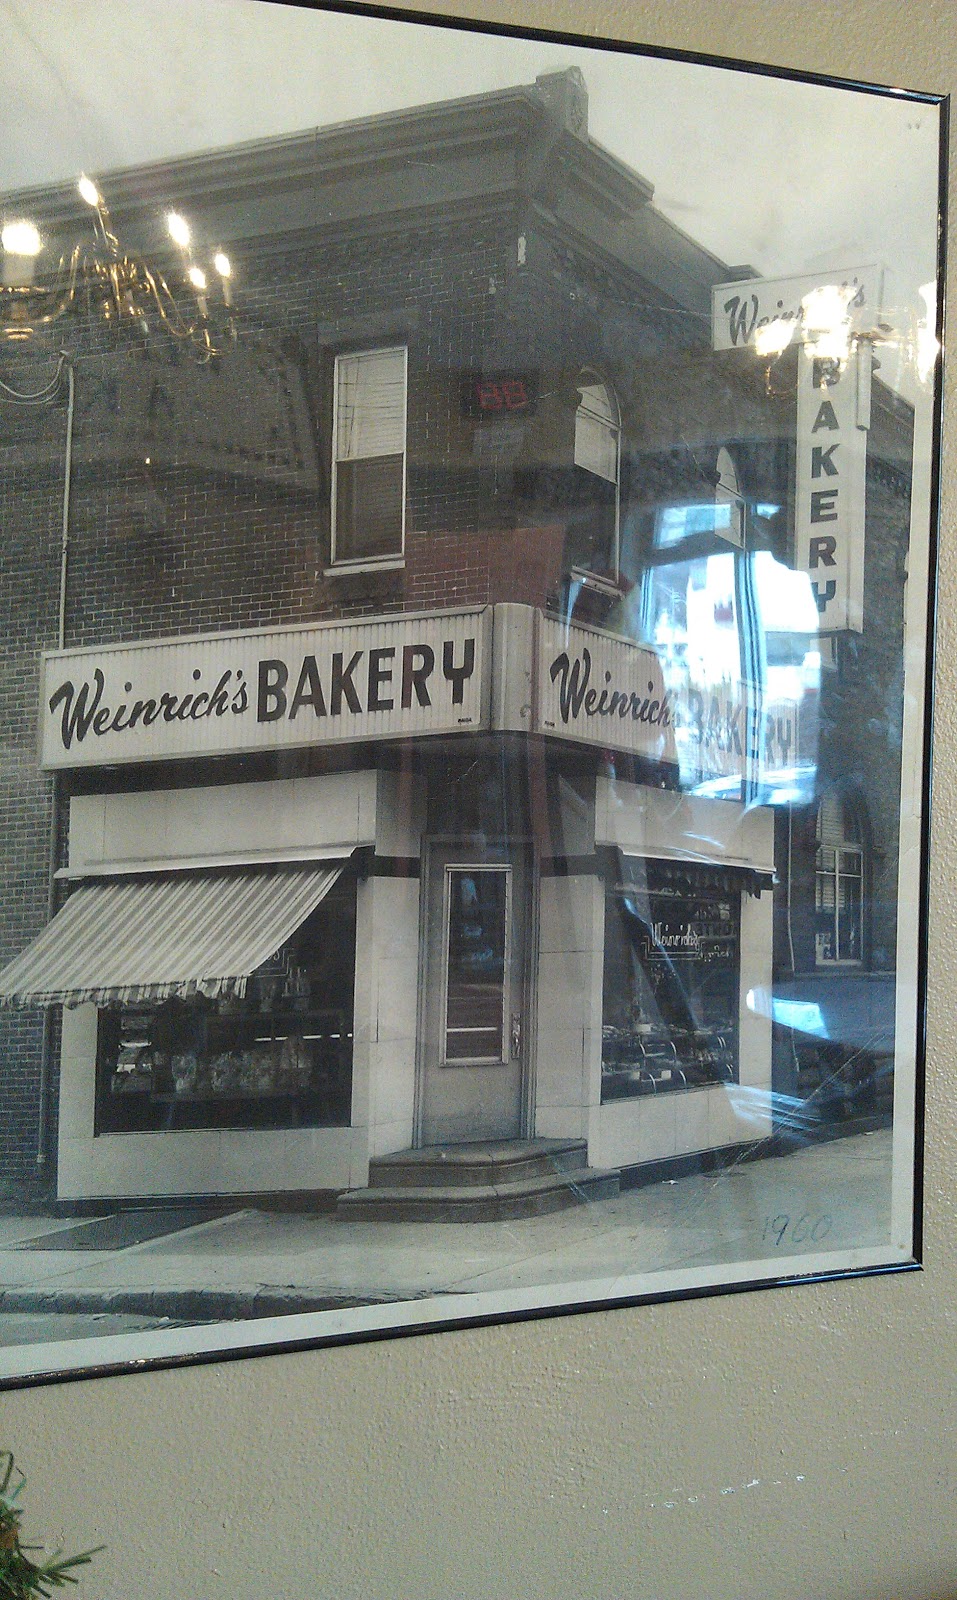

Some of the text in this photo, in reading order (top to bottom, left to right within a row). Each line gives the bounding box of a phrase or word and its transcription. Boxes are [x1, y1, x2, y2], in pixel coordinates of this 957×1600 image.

[808, 357, 841, 613] BAKERY
[49, 638, 475, 750] Weinrich's BAKERY
[762, 1213, 833, 1246] 1960
